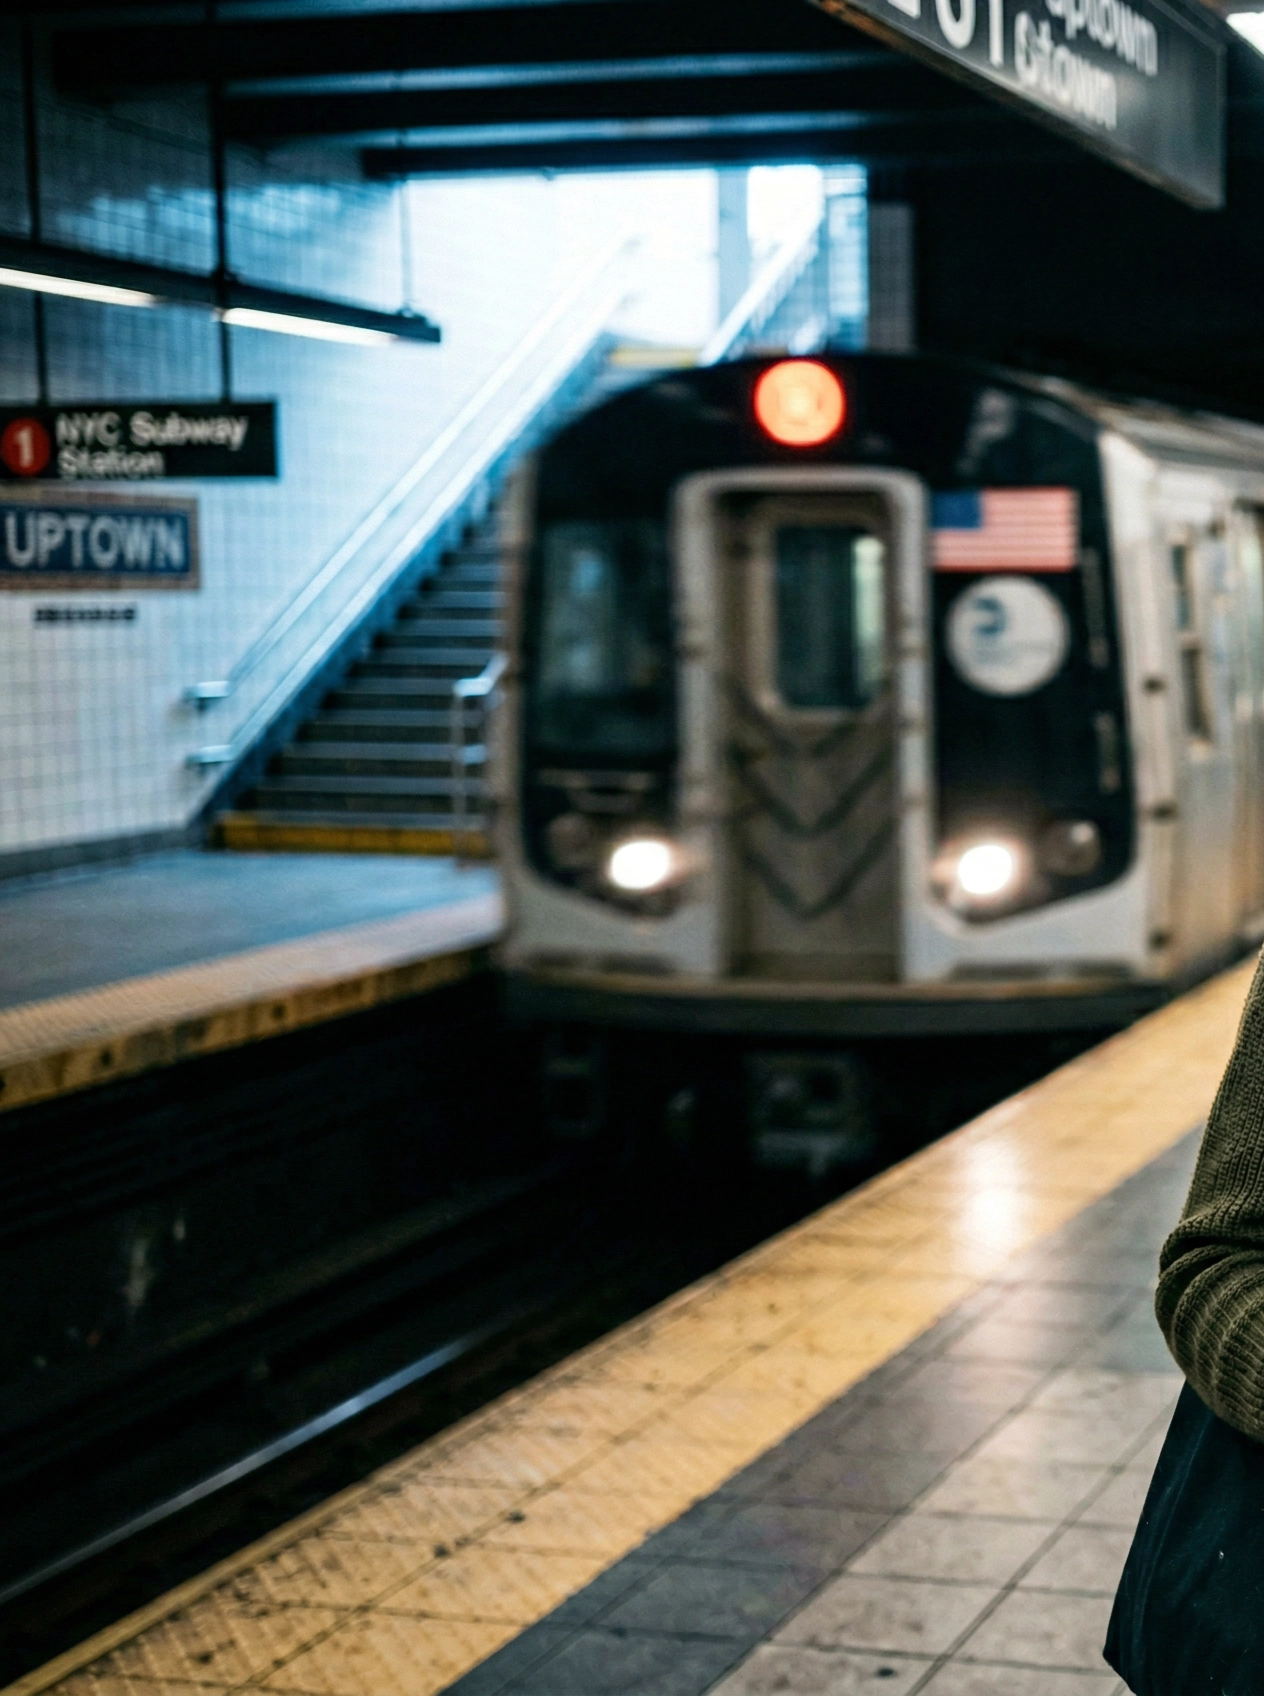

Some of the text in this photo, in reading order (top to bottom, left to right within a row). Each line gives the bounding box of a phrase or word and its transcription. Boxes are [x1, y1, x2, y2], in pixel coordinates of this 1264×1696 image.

[56, 411, 249, 451] NYC Subway
[58, 446, 165, 481] Station
[5, 511, 185, 569] UPTOWN
